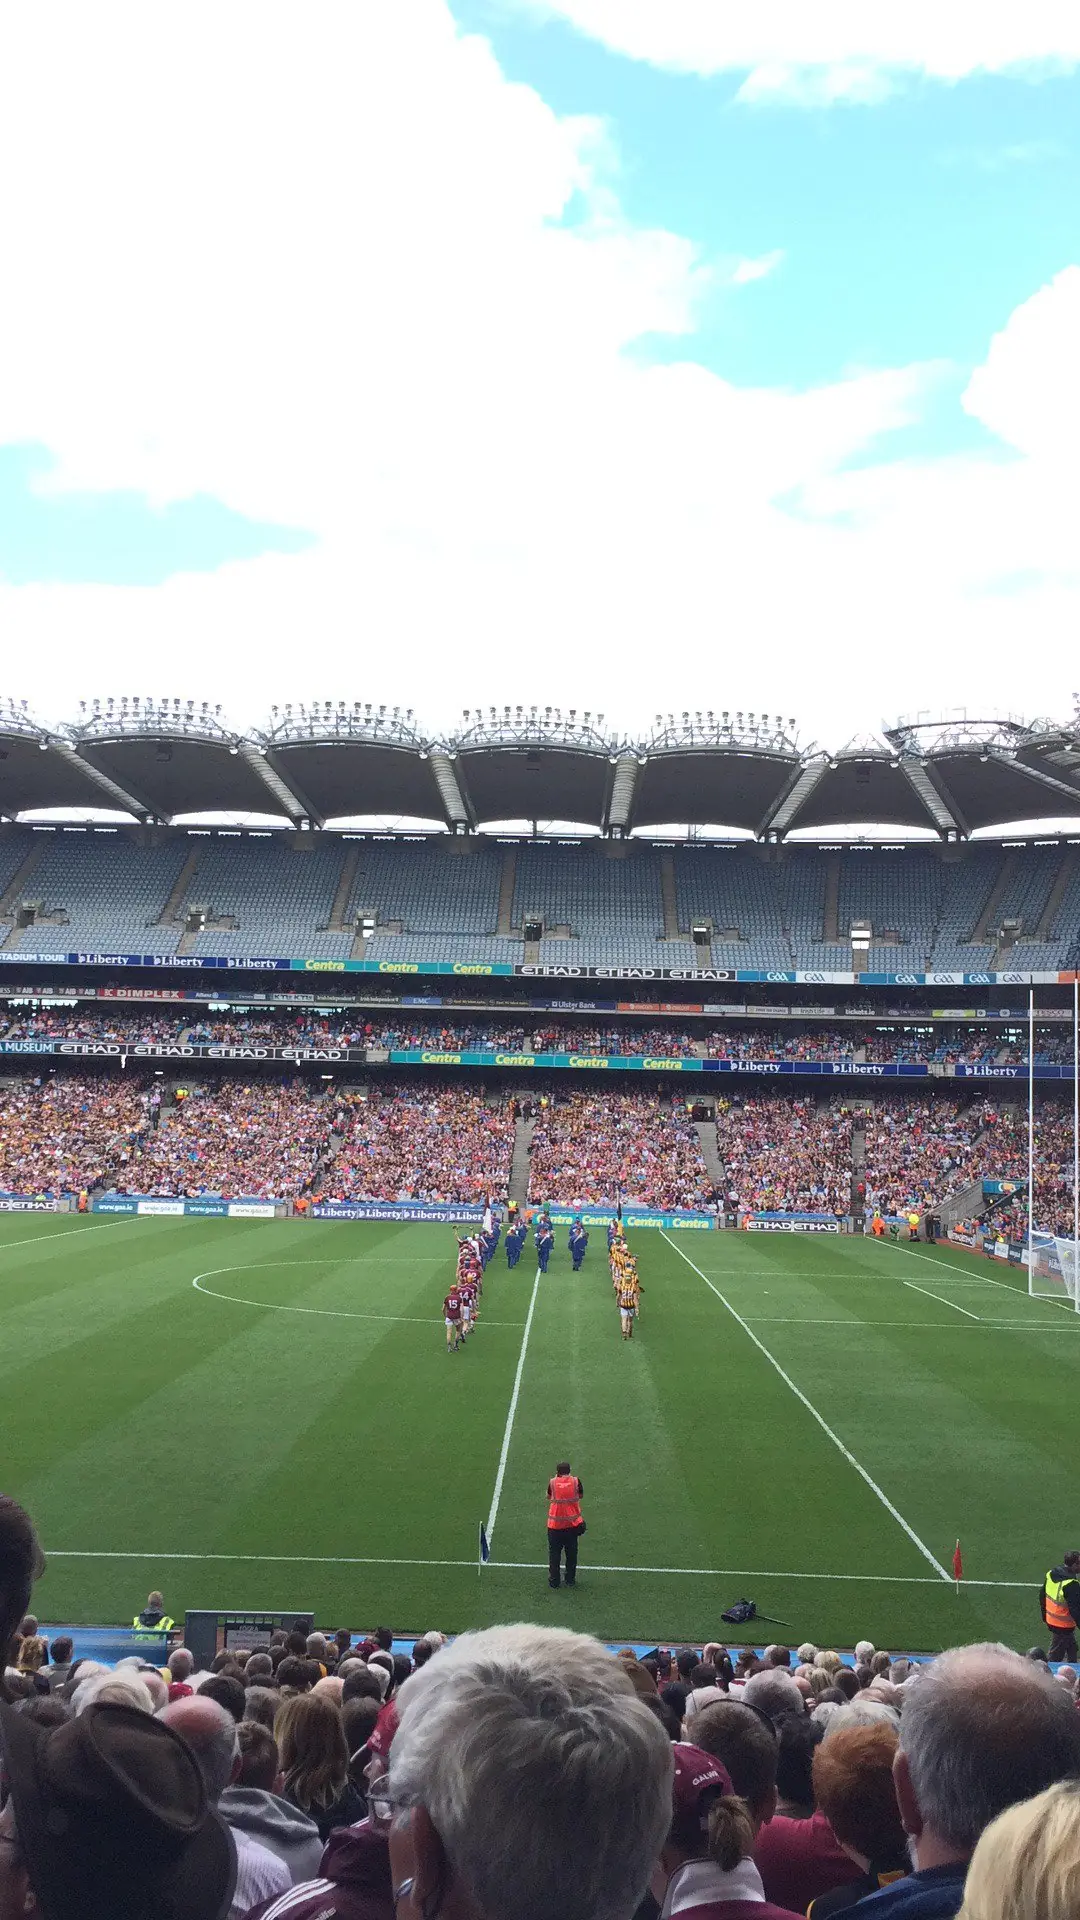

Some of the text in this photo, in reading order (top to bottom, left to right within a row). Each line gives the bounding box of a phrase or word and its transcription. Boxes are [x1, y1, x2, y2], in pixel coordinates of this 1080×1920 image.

[39, 954, 65, 962] TOUR
[87, 954, 129, 965] Liberty
[162, 956, 204, 967] Liberty
[235, 958, 278, 969] Liberty
[305, 959, 345, 971] Centra
[379, 961, 419, 973] Centra
[453, 963, 493, 975] Centra
[521, 966, 581, 976] ETIHAD
[595, 968, 655, 978] ETIHAD
[669, 969, 729, 980] ETIHAD
[767, 971, 789, 981] GAA
[804, 972, 826, 982] GAA
[894, 973, 917, 984] GAA
[933, 973, 956, 984] GAA
[969, 973, 990, 983] GAA
[1002, 972, 1025, 982] GAA
[117, 989, 179, 998] DIMPLEX
[579, 1001, 596, 1009] Bank
[5, 1043, 52, 1053] MUSEUM
[60, 1044, 119, 1054] ETIHAD
[134, 1045, 194, 1056] ETIHAD
[208, 1047, 267, 1057] ETIHAD
[281, 1050, 341, 1060] ETIHAD
[421, 1052, 461, 1063] Centra
[495, 1054, 535, 1065] Centra
[569, 1056, 609, 1067] Centra
[643, 1058, 682, 1069] Centra
[738, 1061, 781, 1072] Liberty
[841, 1064, 884, 1075] Liberty
[973, 1065, 1018, 1077] Liberty
[13, 1201, 54, 1210] ETIHAD
[98, 1204, 133, 1212] www.gaa.ie
[189, 1206, 224, 1214] www.gaa.ie
[321, 1208, 357, 1218] Liberty
[366, 1209, 402, 1219] Liberty
[411, 1210, 447, 1221] Liberty
[456, 1211, 487, 1221] Liber
[627, 1216, 663, 1227] Centra
[672, 1217, 709, 1228] Centra
[749, 1221, 791, 1229] ETIHAD
[794, 1223, 837, 1231] ETIHAD
[459, 1291, 469, 1300] 14
[622, 1290, 632, 1298] 22
[448, 1299, 458, 1309] 15
